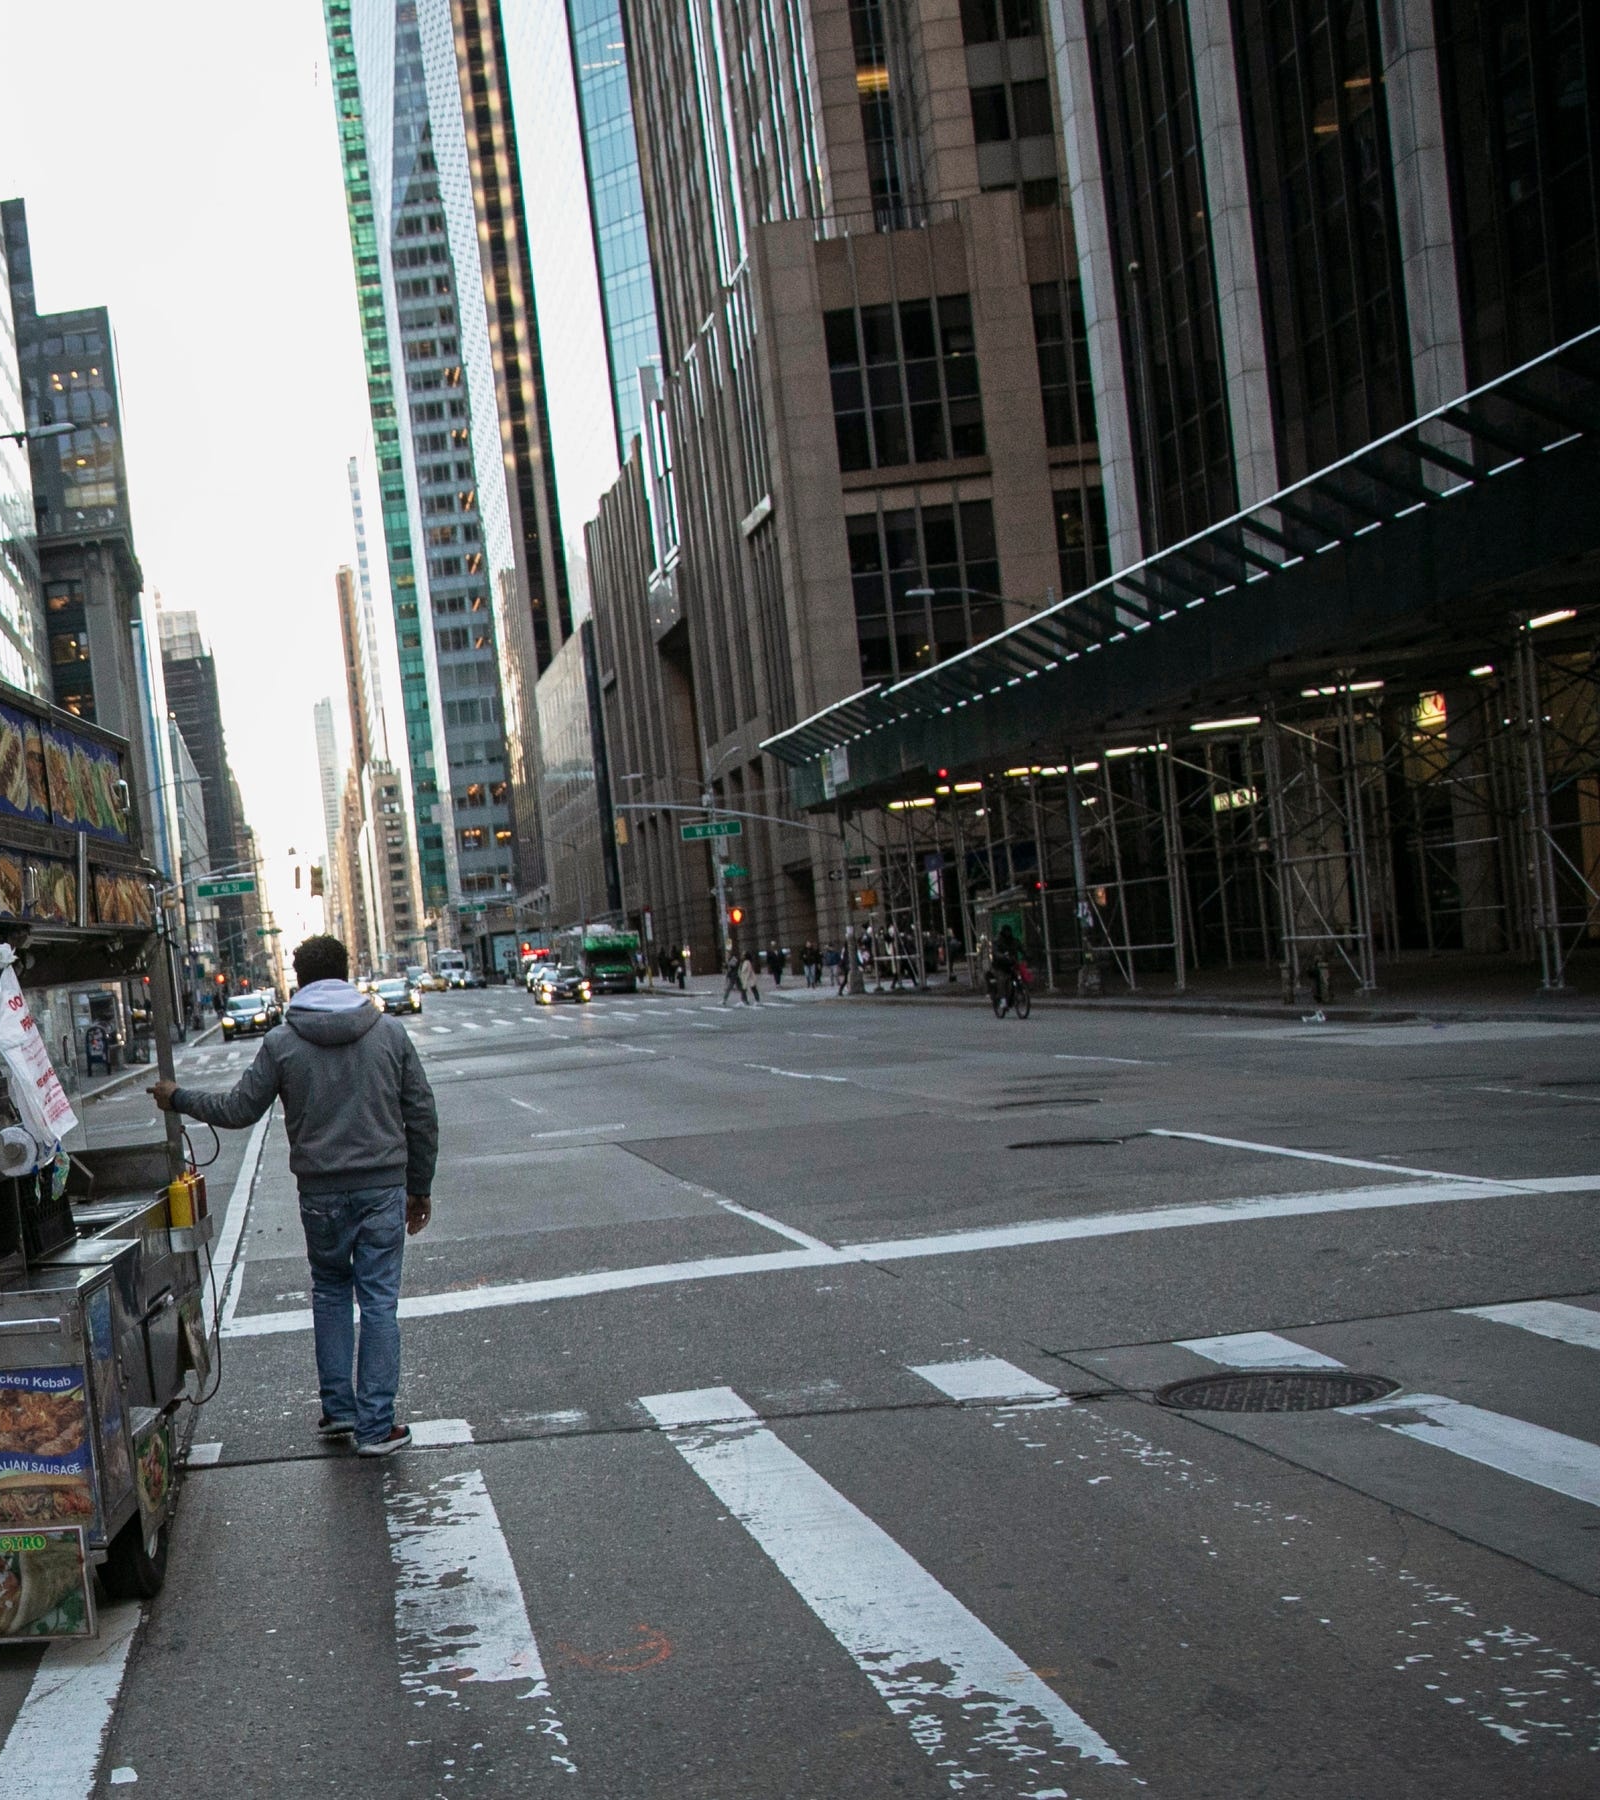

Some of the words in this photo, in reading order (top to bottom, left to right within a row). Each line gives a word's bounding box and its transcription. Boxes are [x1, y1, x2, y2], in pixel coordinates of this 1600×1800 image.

[33, 1375, 71, 1389] Kebab
[31, 1461, 83, 1476] SAUSAGE
[0, 1534, 47, 1552] GYRO
